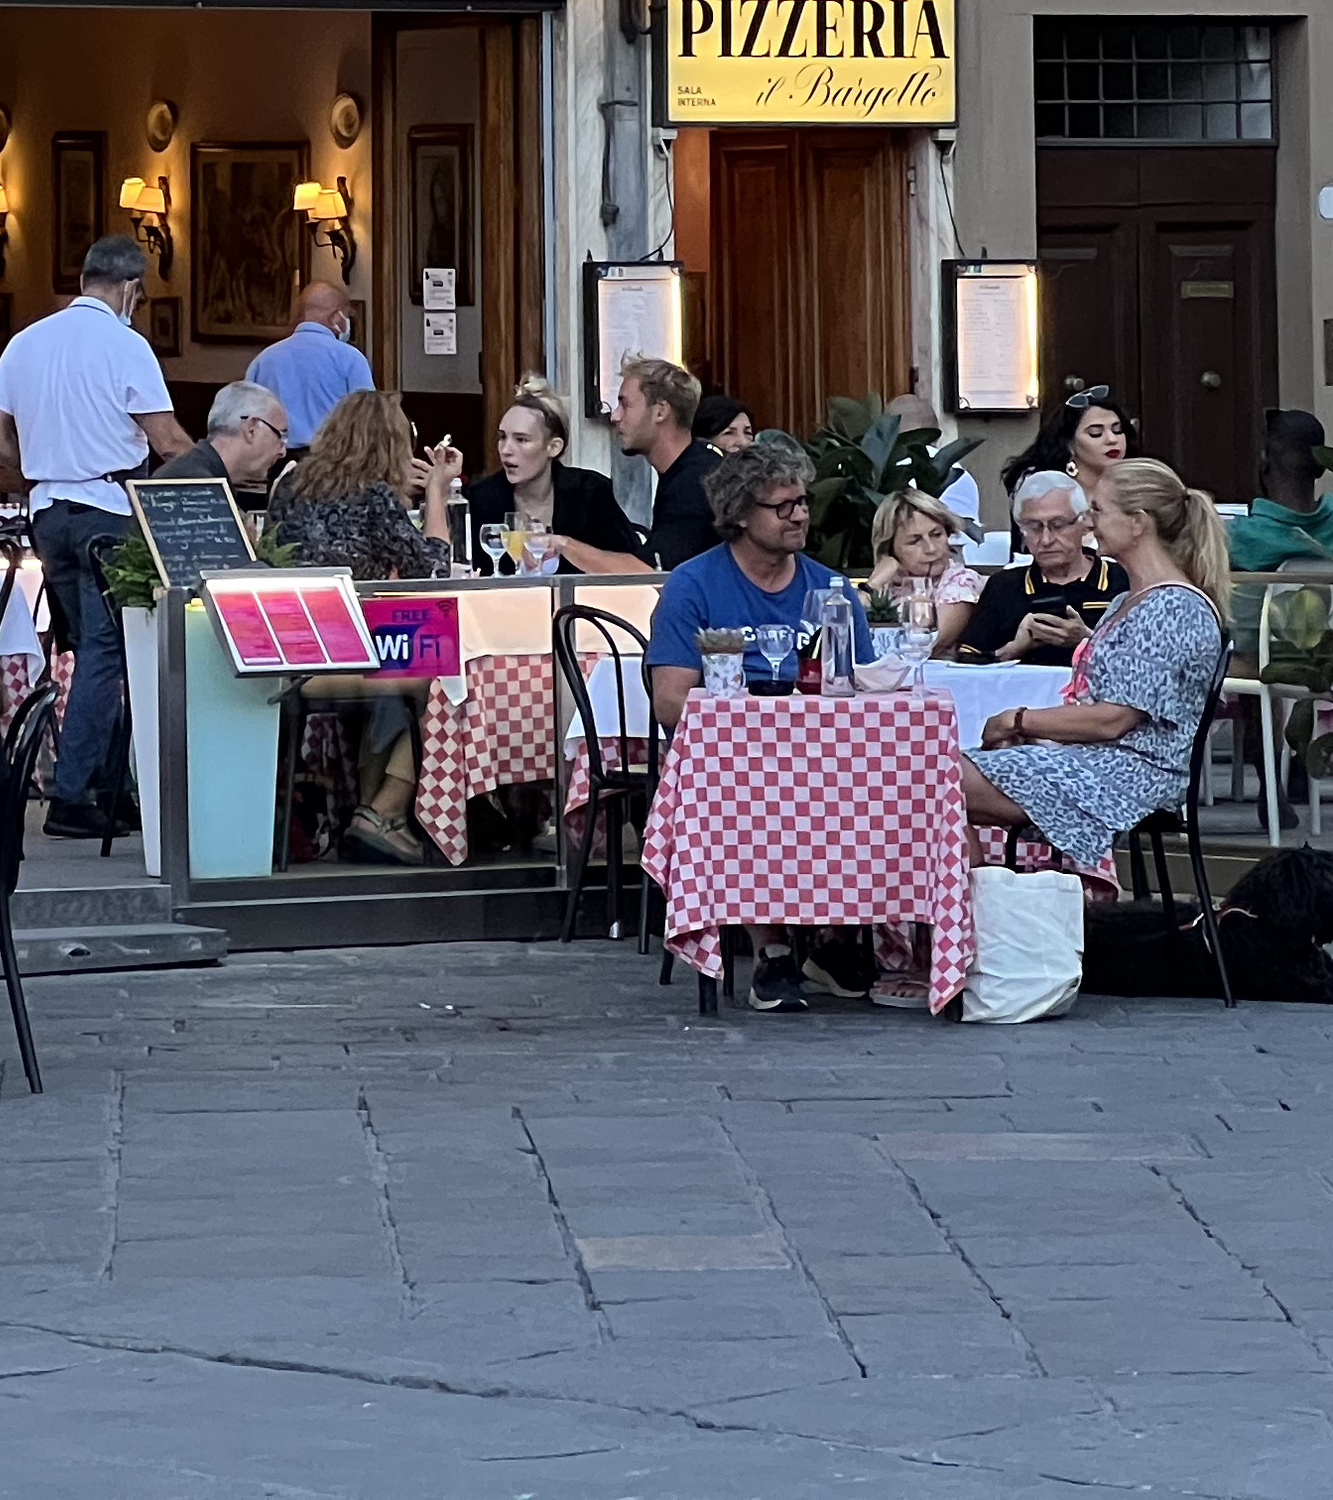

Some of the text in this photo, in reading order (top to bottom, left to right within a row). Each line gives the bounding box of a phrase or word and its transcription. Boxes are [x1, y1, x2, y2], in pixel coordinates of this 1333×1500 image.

[677, 85, 703, 95] SALA
[755, 63, 944, 118] il Bargello
[677, 97, 717, 107] INTERNA
[392, 608, 430, 622] FREE
